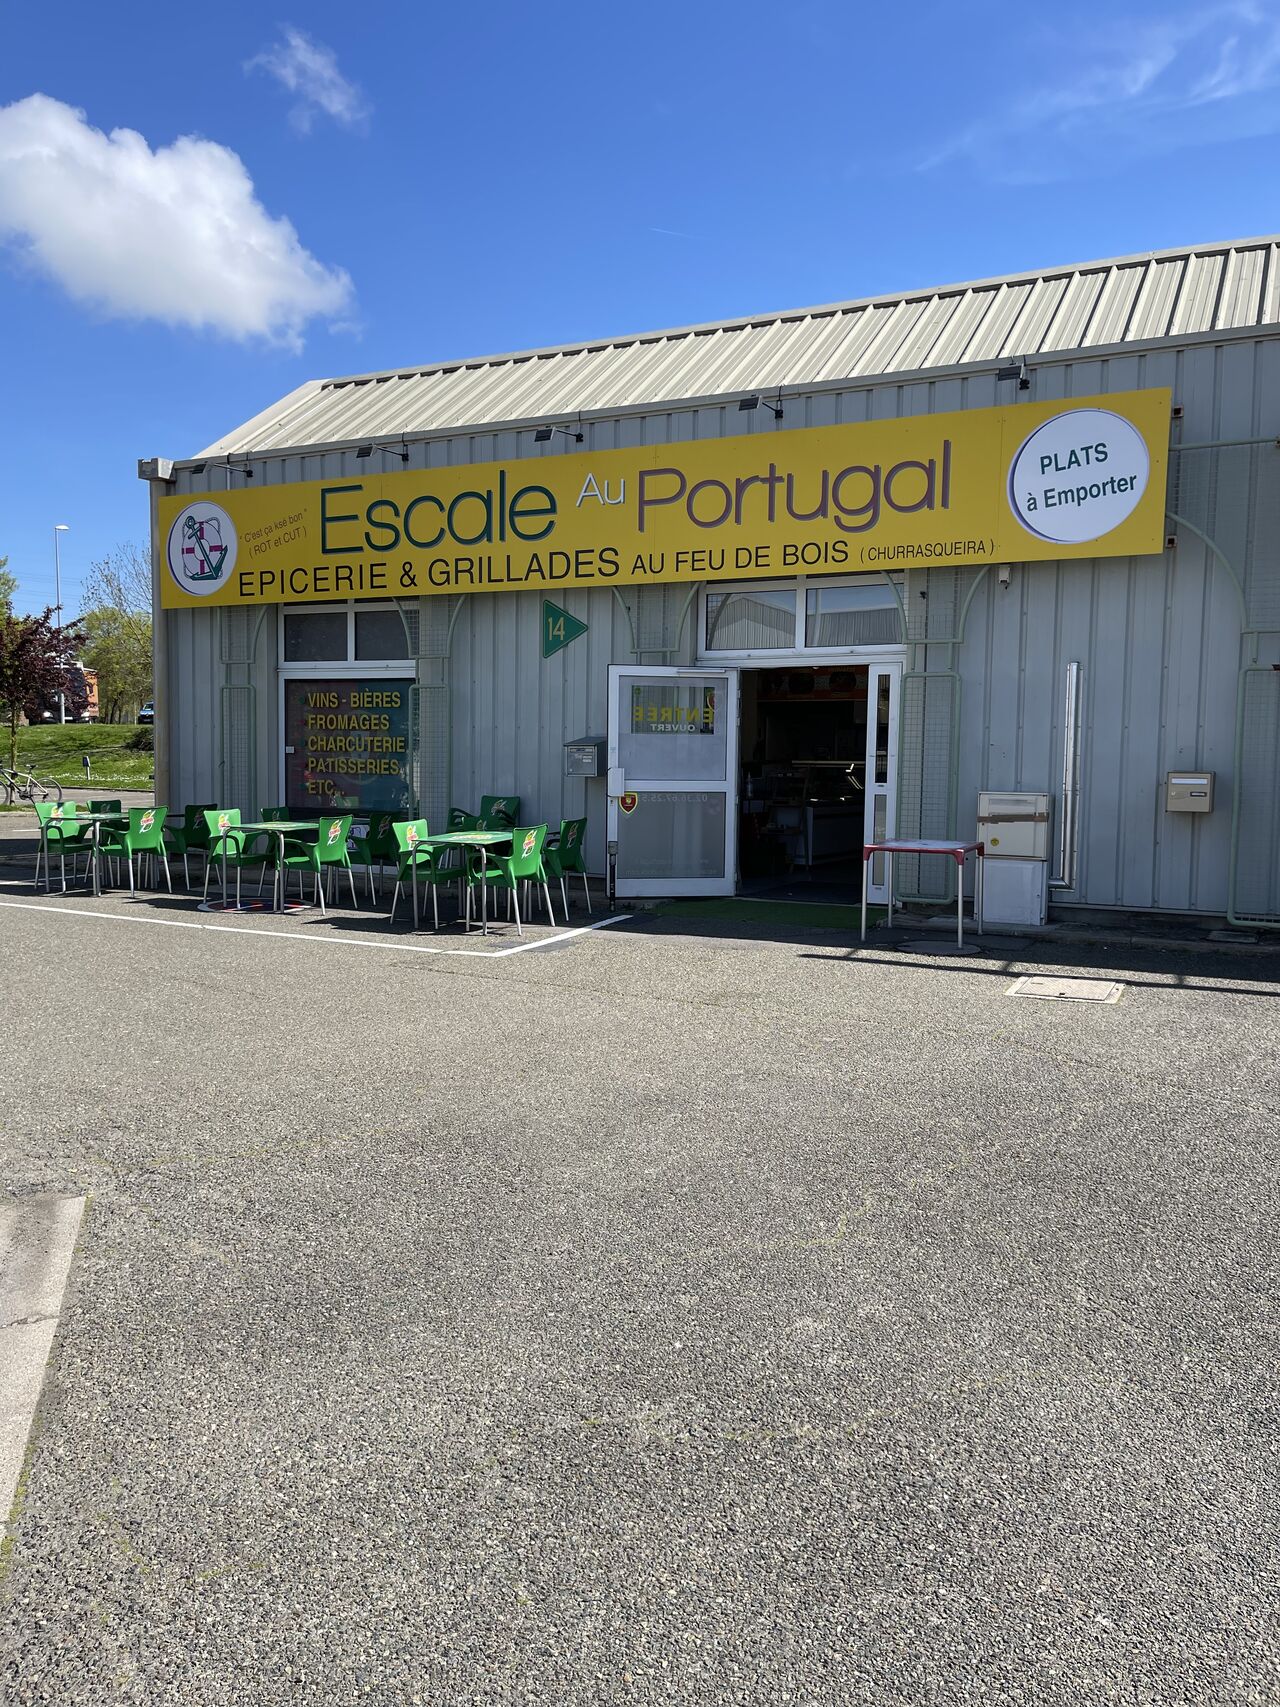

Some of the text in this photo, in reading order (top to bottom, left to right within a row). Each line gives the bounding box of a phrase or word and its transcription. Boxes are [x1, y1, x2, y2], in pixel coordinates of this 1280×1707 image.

[1040, 442, 1108, 475] PLATS
[321, 439, 951, 555] Escale Au Portugal
[1026, 475, 1137, 512] à Emporter
[244, 528, 263, 543] C'est
[264, 525, 274, 537] ça
[288, 511, 304, 525] bon
[253, 539, 271, 556] ROT
[274, 536, 282, 547] et
[283, 526, 301, 543] CUT
[239, 563, 388, 597] EPICERIE
[399, 561, 418, 588] &
[428, 547, 620, 587] GRILLADES
[631, 553, 665, 575] AU
[675, 548, 725, 572] FEU
[735, 546, 771, 569] DE
[782, 540, 849, 566] BOIS
[867, 540, 986, 561] CHURRASQUEIRA
[548, 616, 565, 641] 14
[307, 692, 339, 708] VINS
[350, 687, 401, 708] BIÈRES
[307, 714, 390, 730] FROMAGES
[307, 736, 406, 753] CHARCUTERIE
